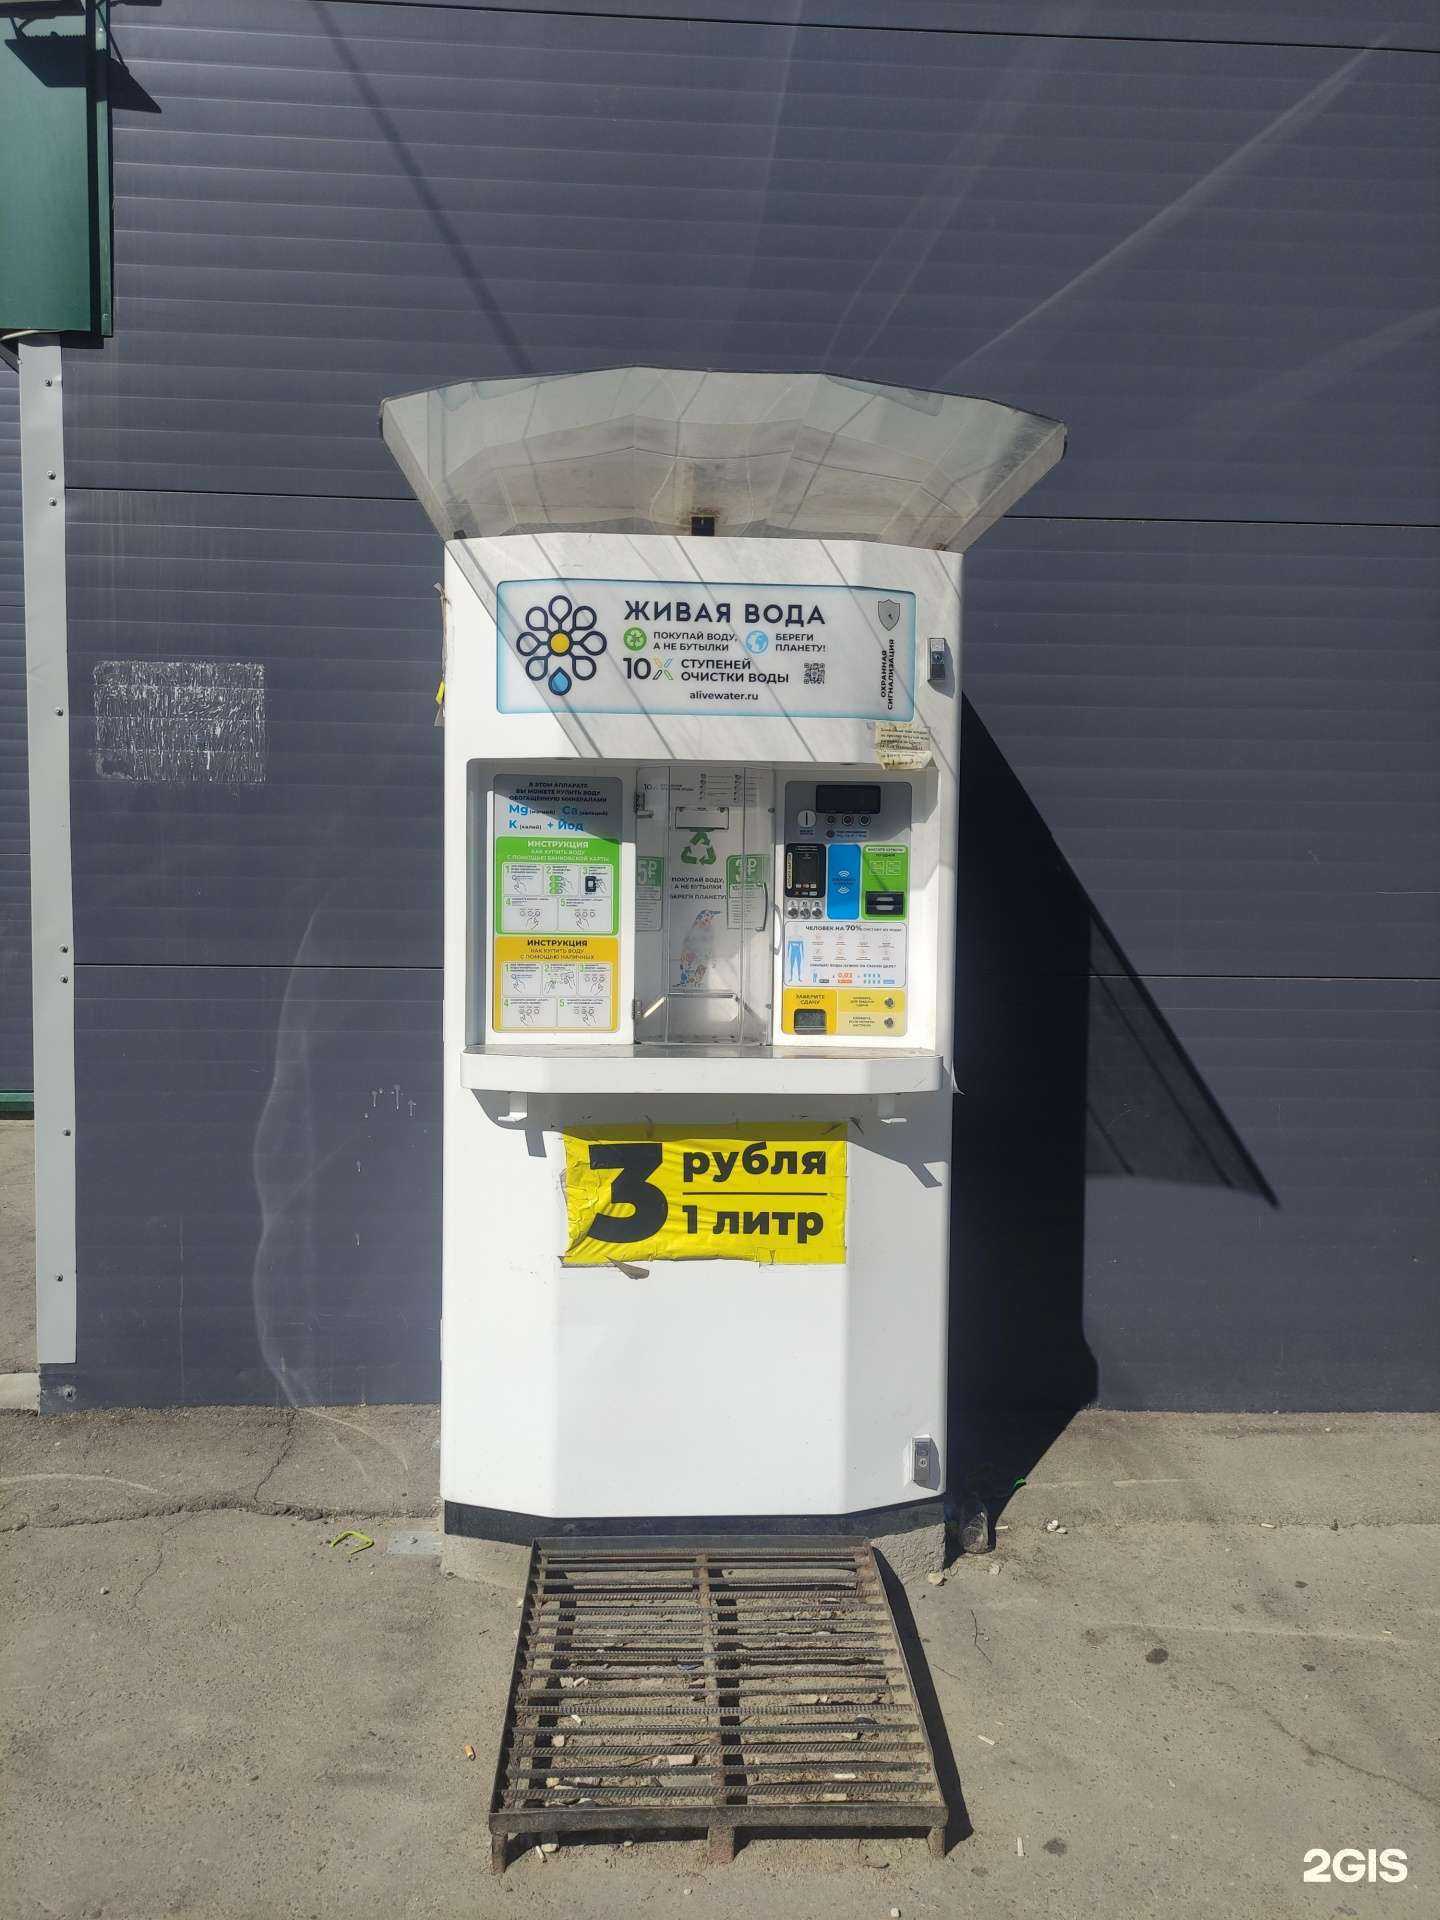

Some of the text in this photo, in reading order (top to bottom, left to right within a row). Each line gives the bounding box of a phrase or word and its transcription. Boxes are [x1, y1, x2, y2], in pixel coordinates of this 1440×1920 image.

[624, 600, 826, 627] ЖИВАЯ ВОДА
[653, 630, 738, 642] ПОКУПАЙ ВОДУ,
[775, 633, 814, 641] БЕРЕГИ
[664, 643, 677, 651] НЕ
[775, 644, 826, 653] ПЛАНЕТУ!
[681, 657, 751, 670] СТУПЕНЕЙ
[681, 671, 789, 684] ОЧИСТКИ ВОДЫ
[887, 639, 896, 710] СИГНАЛИЗАЦИЯ
[689, 691, 759, 701] alivewater.ru
[508, 804, 528, 816] Mg
[562, 806, 578, 816] Ca
[558, 819, 584, 831] Йод
[528, 840, 589, 849] ИНСТРУКЦИЯ
[527, 939, 588, 947] ИНСТРУКЦИЯ
[683, 1141, 827, 1183] рубля
[588, 1143, 669, 1243] 3
[683, 1205, 824, 1244] 1 литр
